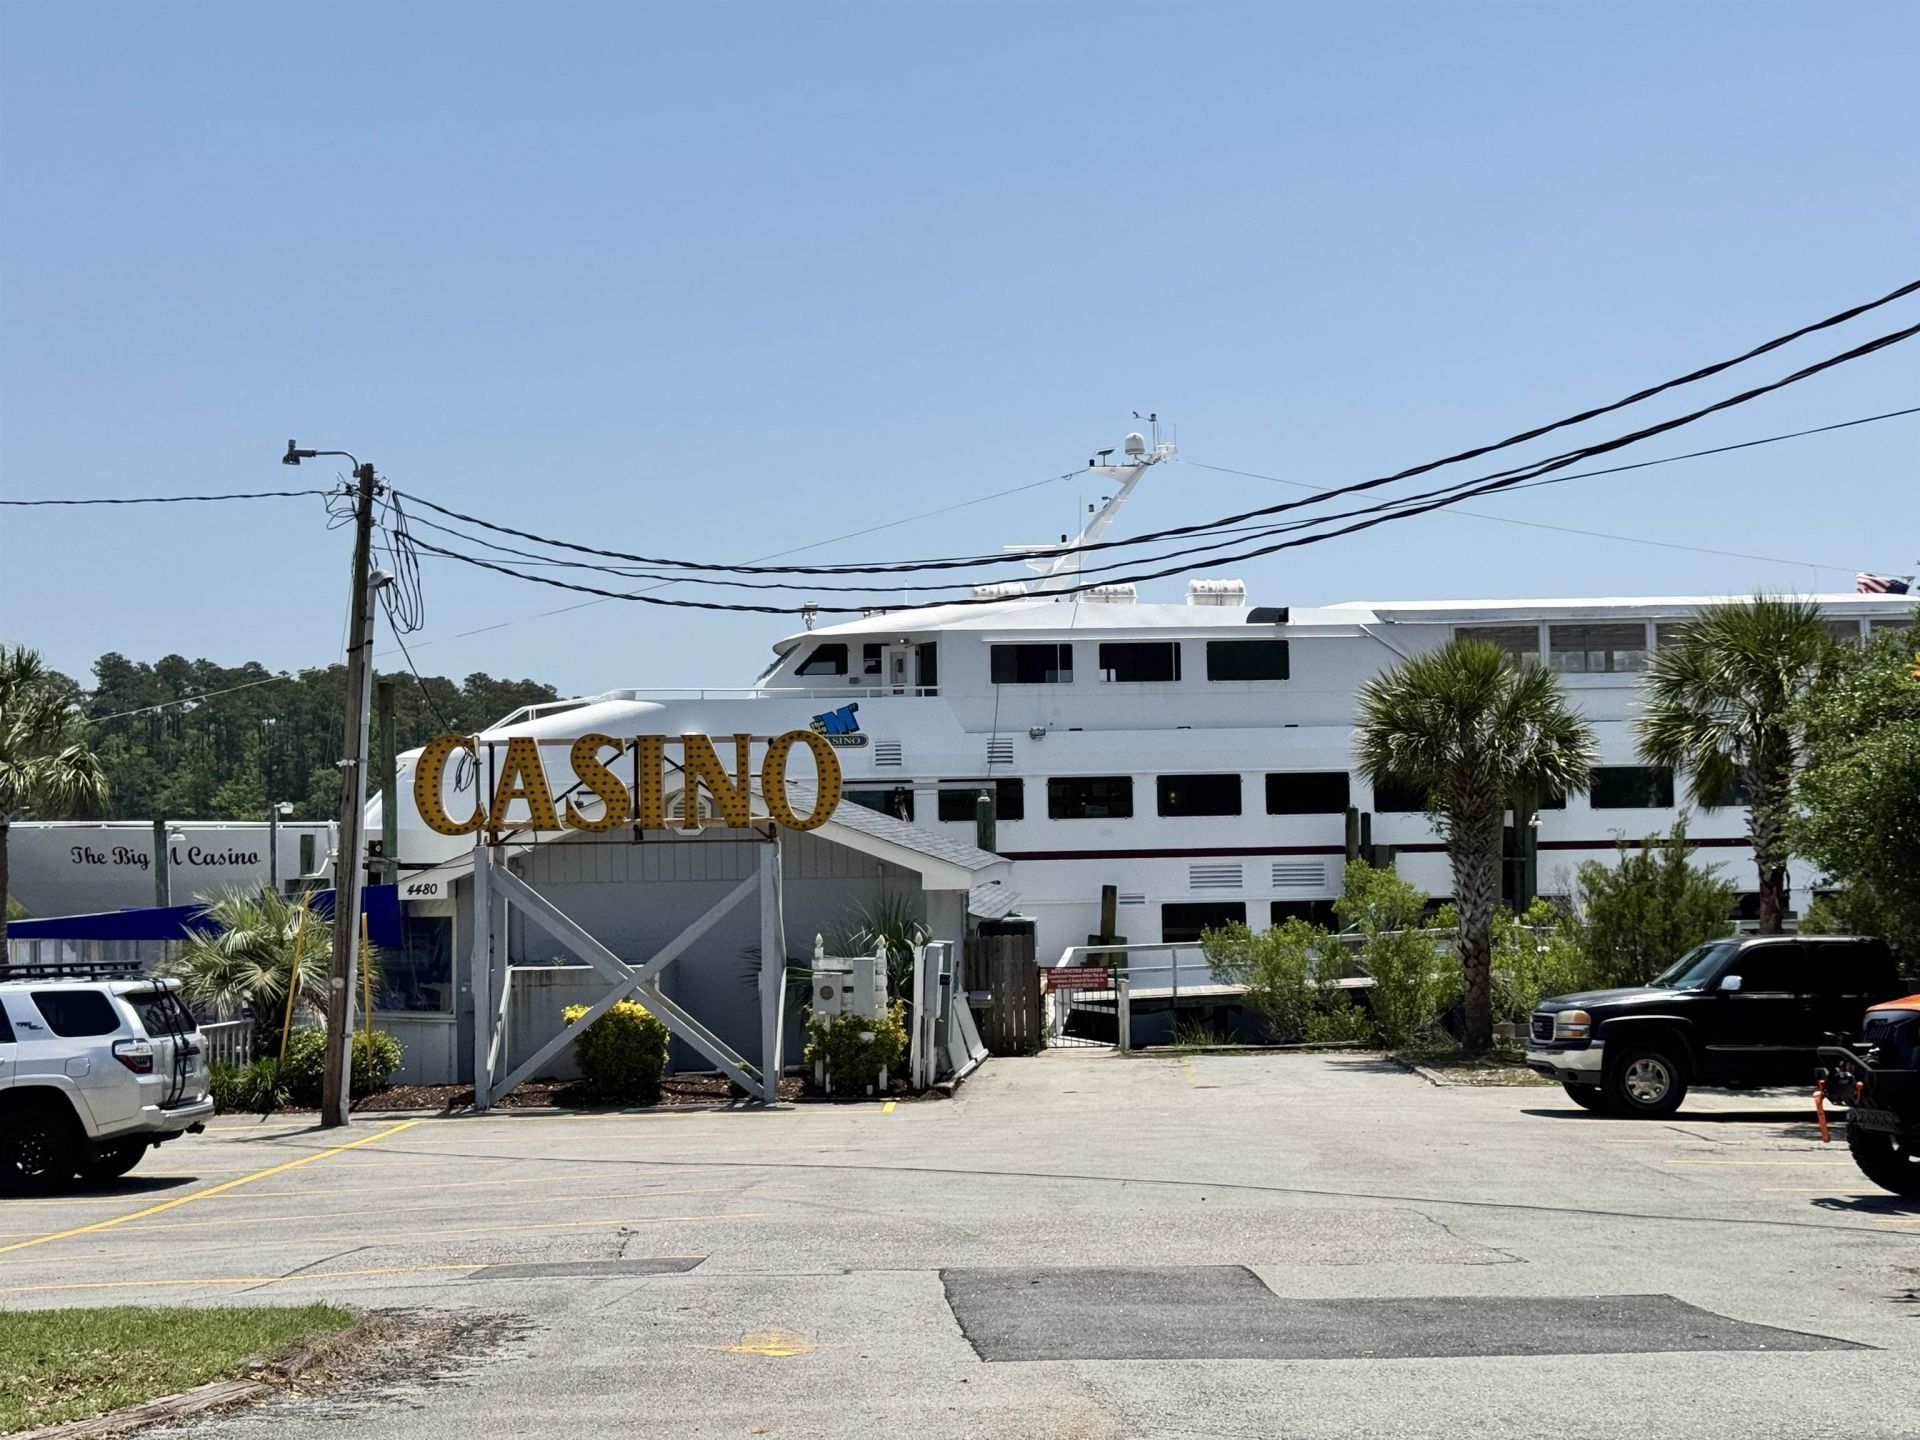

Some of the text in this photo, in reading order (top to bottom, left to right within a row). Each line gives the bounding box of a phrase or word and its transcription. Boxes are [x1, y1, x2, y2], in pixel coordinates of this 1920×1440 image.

[414, 730, 842, 836] CASINO
[71, 846, 108, 865] The
[112, 846, 151, 871] Big
[187, 846, 261, 866] Casino
[407, 883, 438, 895] 4480
